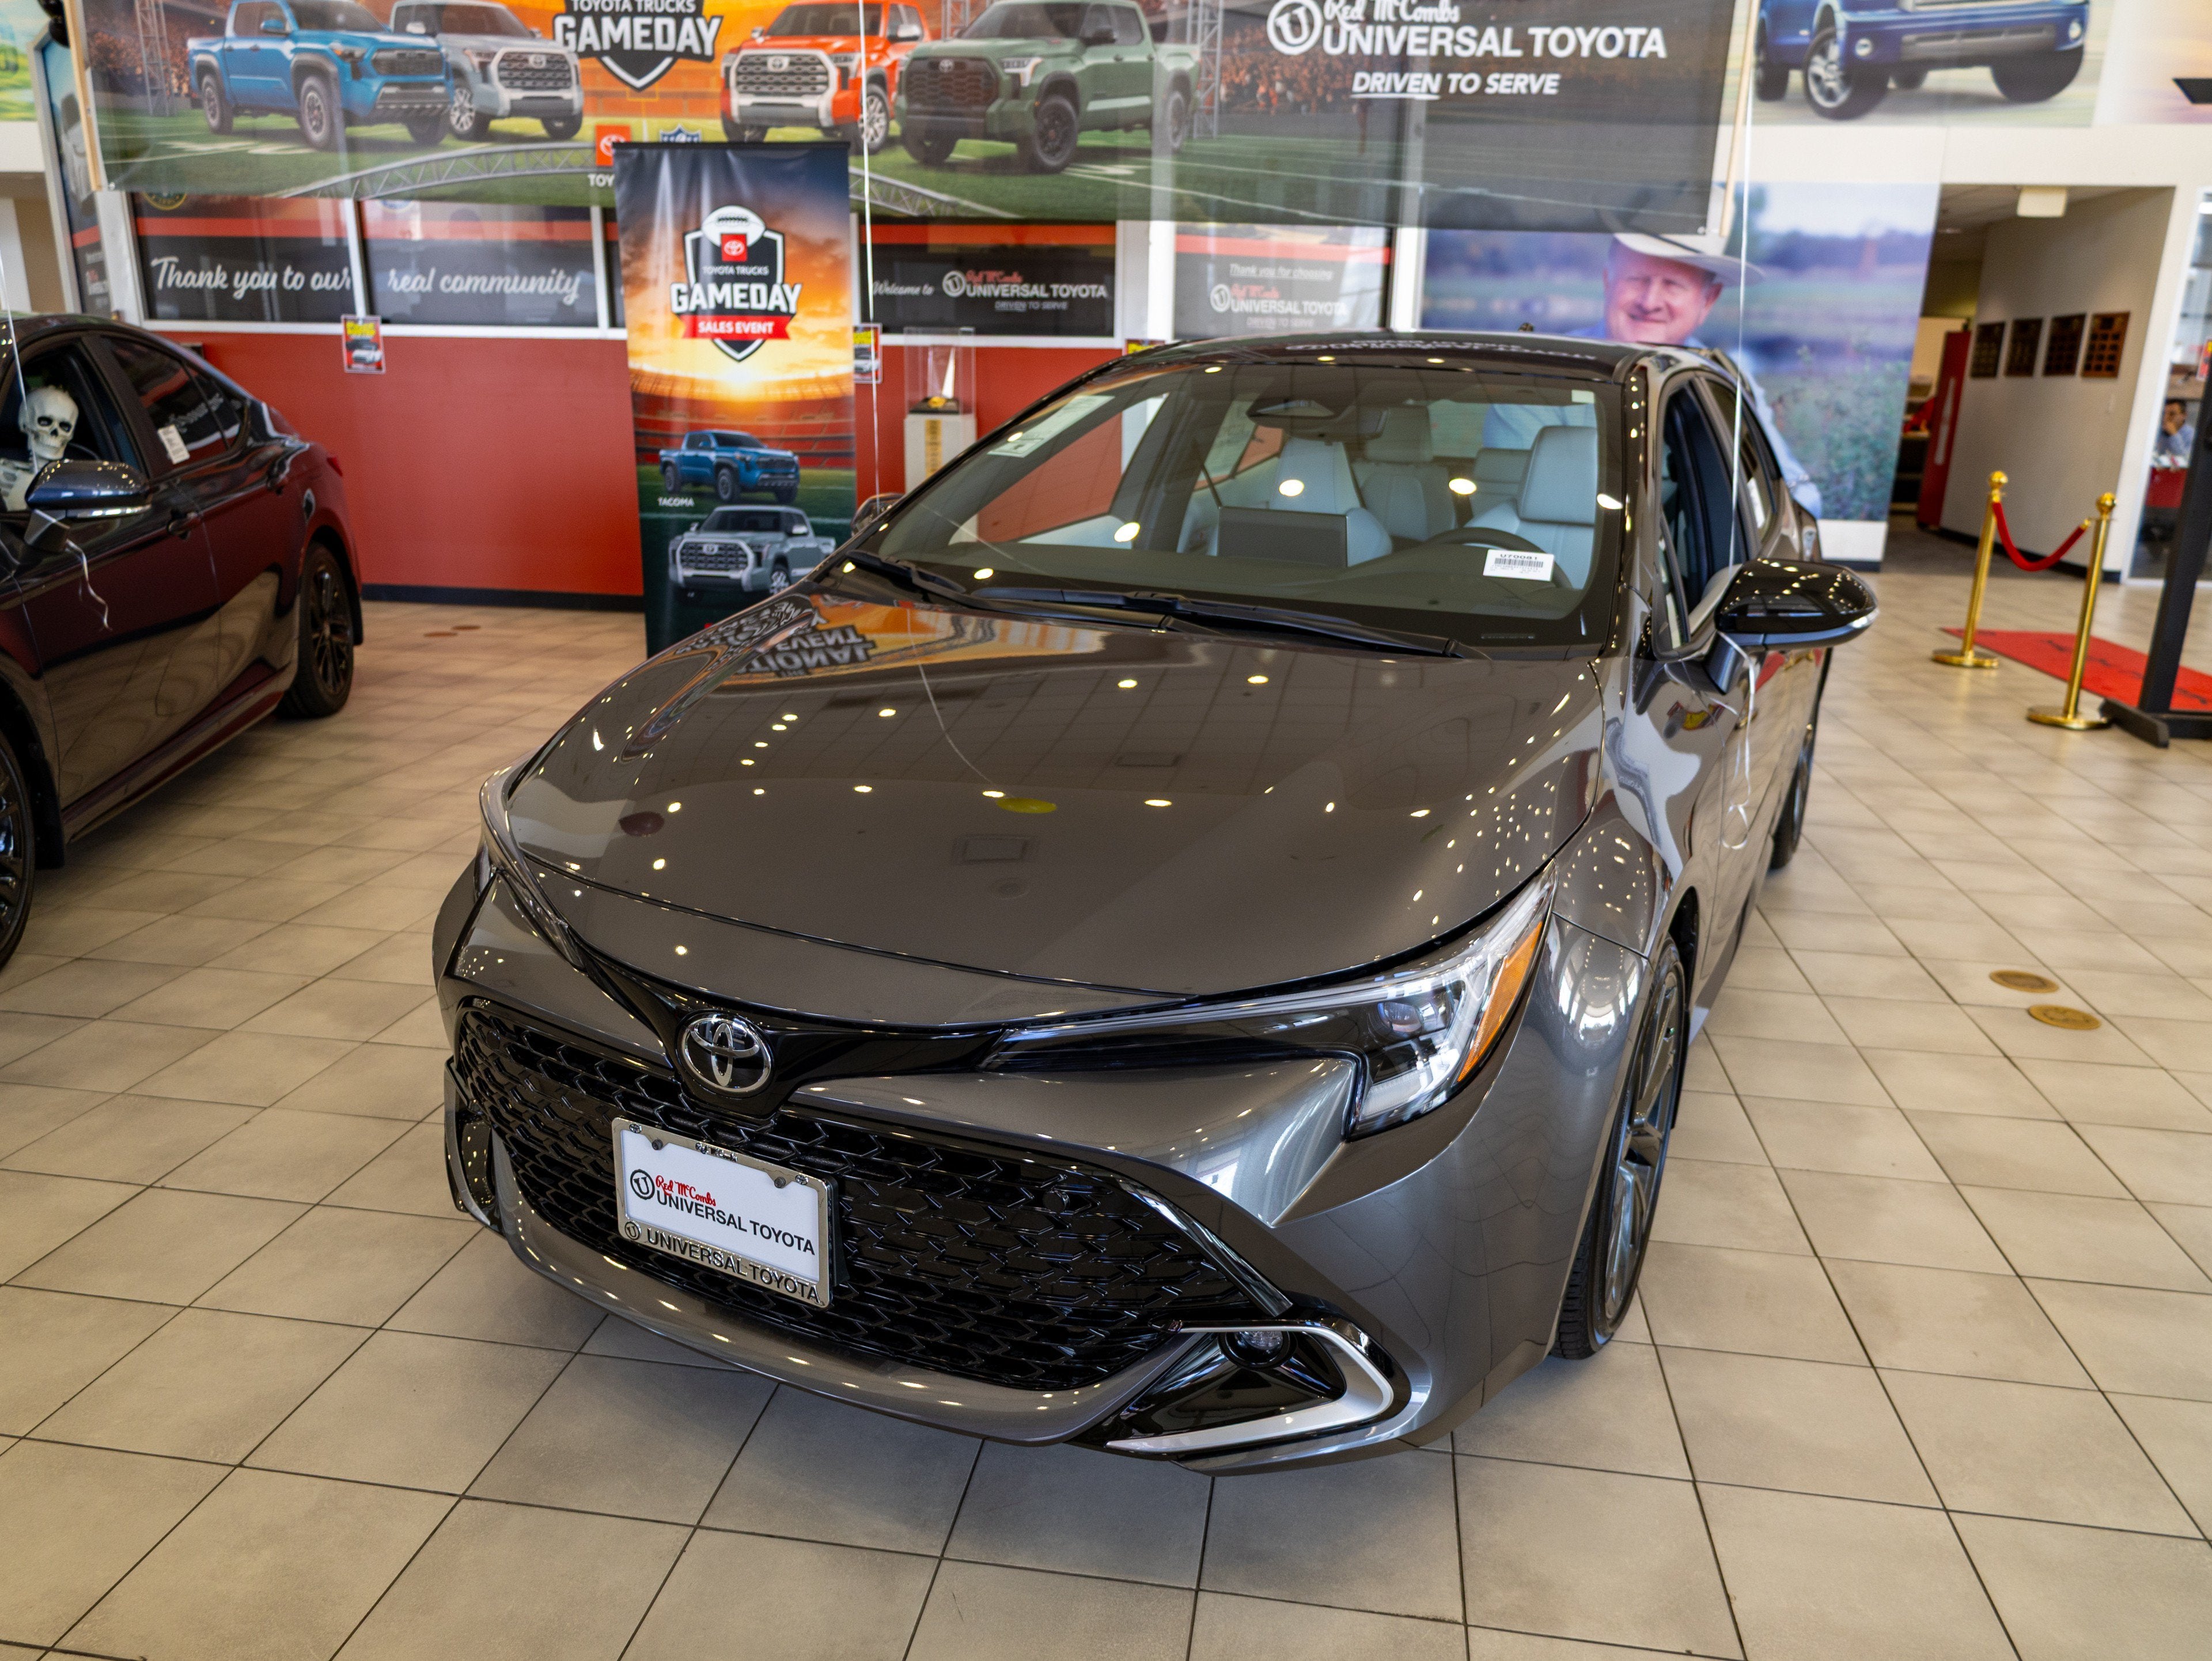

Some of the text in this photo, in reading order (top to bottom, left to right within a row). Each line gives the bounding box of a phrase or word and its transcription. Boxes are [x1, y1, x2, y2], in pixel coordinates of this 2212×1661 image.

[571, 0, 696, 13] TOYOTA TRUCKS
[554, 15, 721, 56] GAMEDAY
[1323, 25, 1668, 58] UNIVERSAL TOYOTA
[1352, 71, 1562, 94] DRIVEN TO SERVE
[587, 174, 615, 187] TOY
[150, 255, 352, 300] Thank you to our
[702, 265, 769, 276] TOYOTA TRUCKS
[387, 268, 580, 306] real community
[670, 282, 803, 314] GAMEDAY
[966, 283, 1108, 298] UNIVERSAL TOYOTA
[1230, 299, 1301, 315] UNIVERSAL
[698, 321, 775, 334] SALES EVENT
[657, 497, 695, 507] TACOMA
[656, 1175, 716, 1206] Red McCombs
[657, 1190, 815, 1255] UNIVERSAL TOYOTA
[646, 1228, 824, 1304] UNIVERSAL TOYOTA
